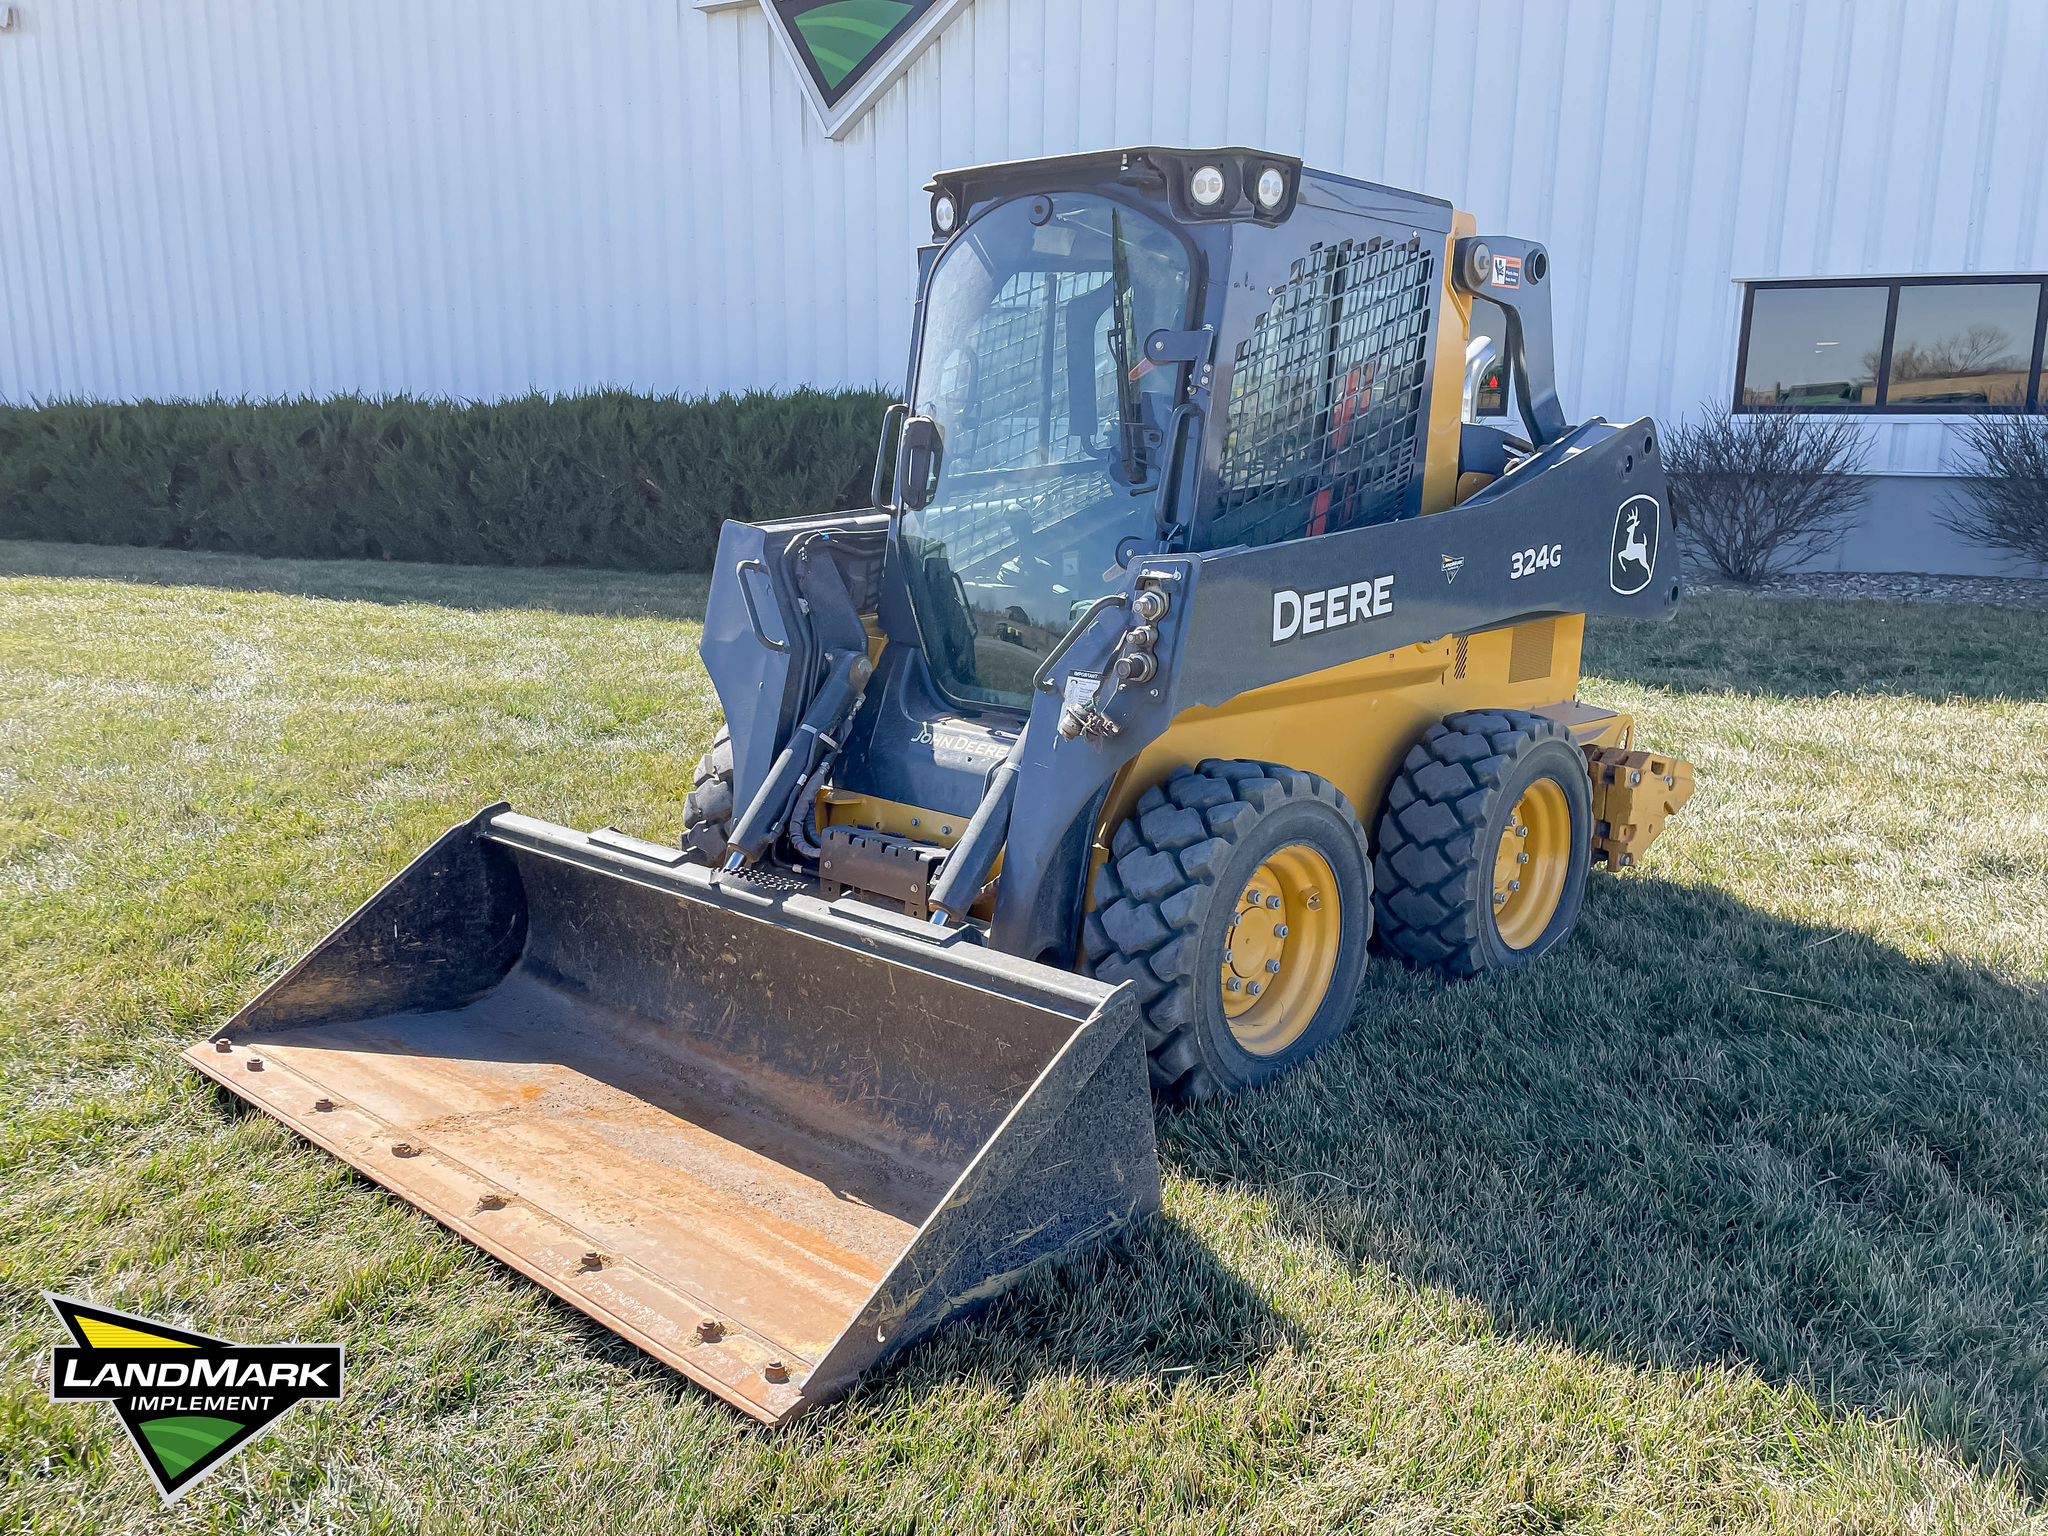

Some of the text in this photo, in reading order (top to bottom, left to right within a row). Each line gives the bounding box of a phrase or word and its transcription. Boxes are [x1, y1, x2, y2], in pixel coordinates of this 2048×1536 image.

[1510, 543, 1562, 580] 324G
[1272, 575, 1394, 643] DEERE
[910, 730, 1011, 758] JOHN DEERE
